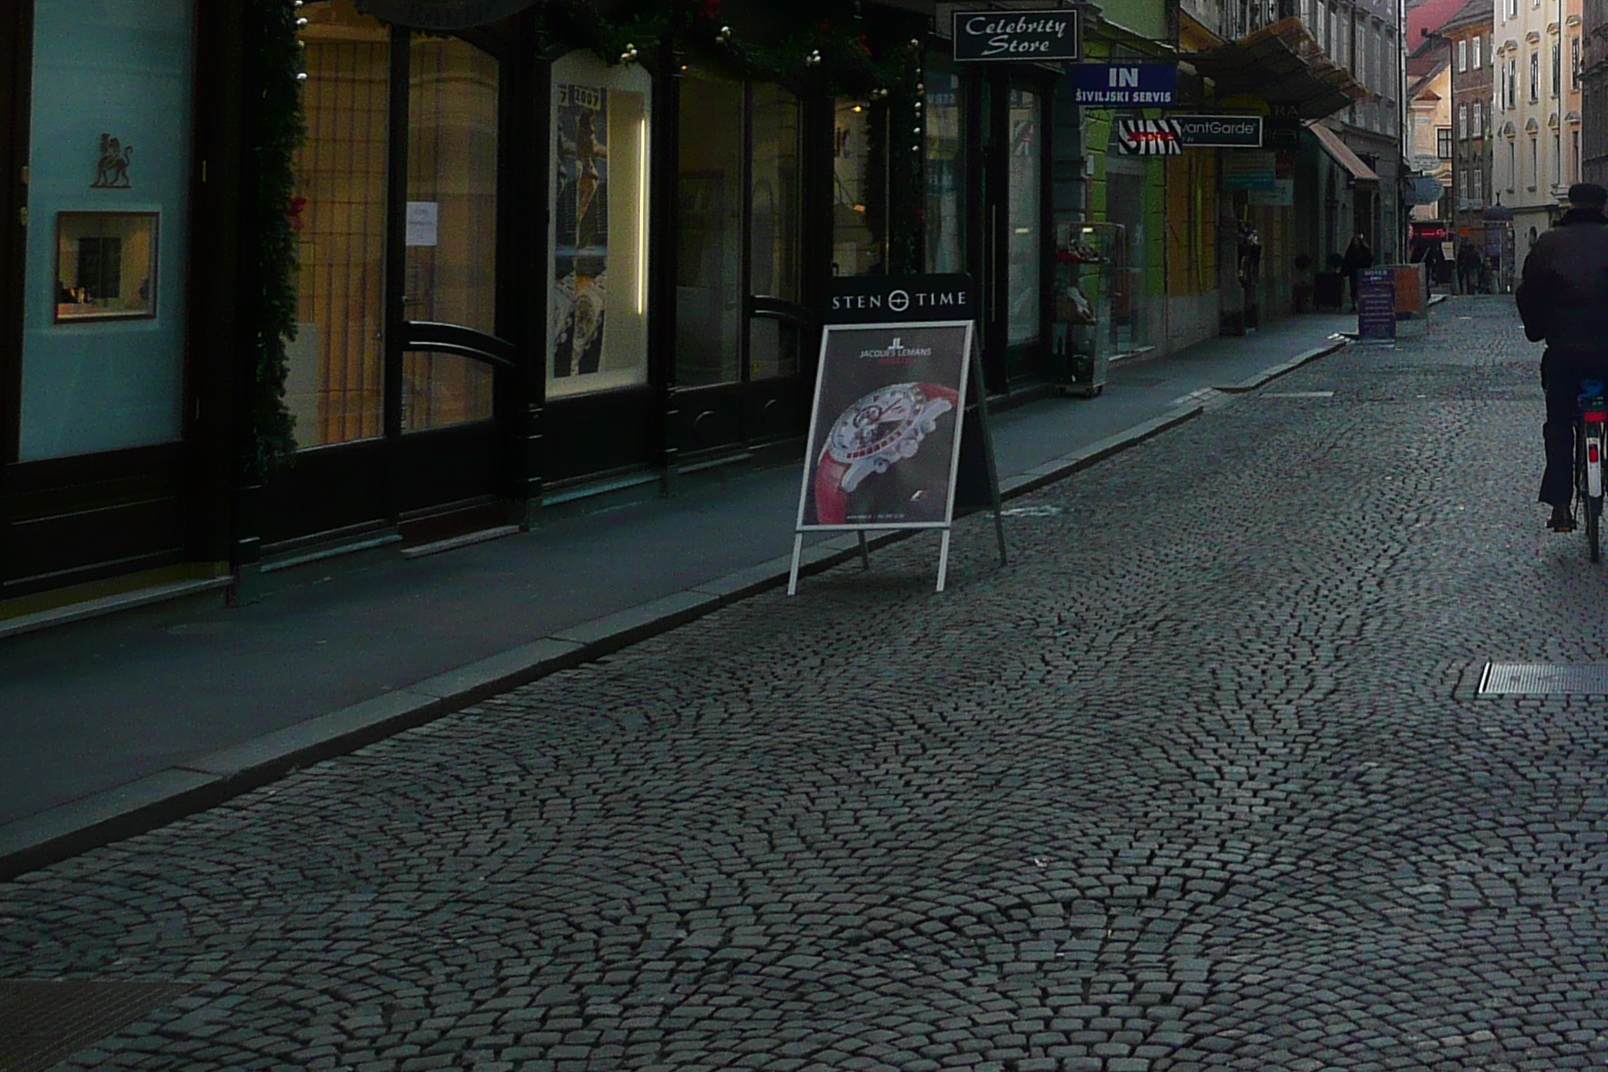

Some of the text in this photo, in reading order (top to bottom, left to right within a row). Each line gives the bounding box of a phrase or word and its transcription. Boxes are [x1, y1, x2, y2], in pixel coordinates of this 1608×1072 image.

[965, 16, 1067, 38] Celebrity
[980, 34, 1050, 57] Store
[1108, 67, 1139, 88] IN
[1132, 91, 1172, 103] SERVIS
[1182, 121, 1255, 136] vantGarde
[832, 291, 967, 310] STEN TIME
[897, 347, 932, 357] LEMANS
